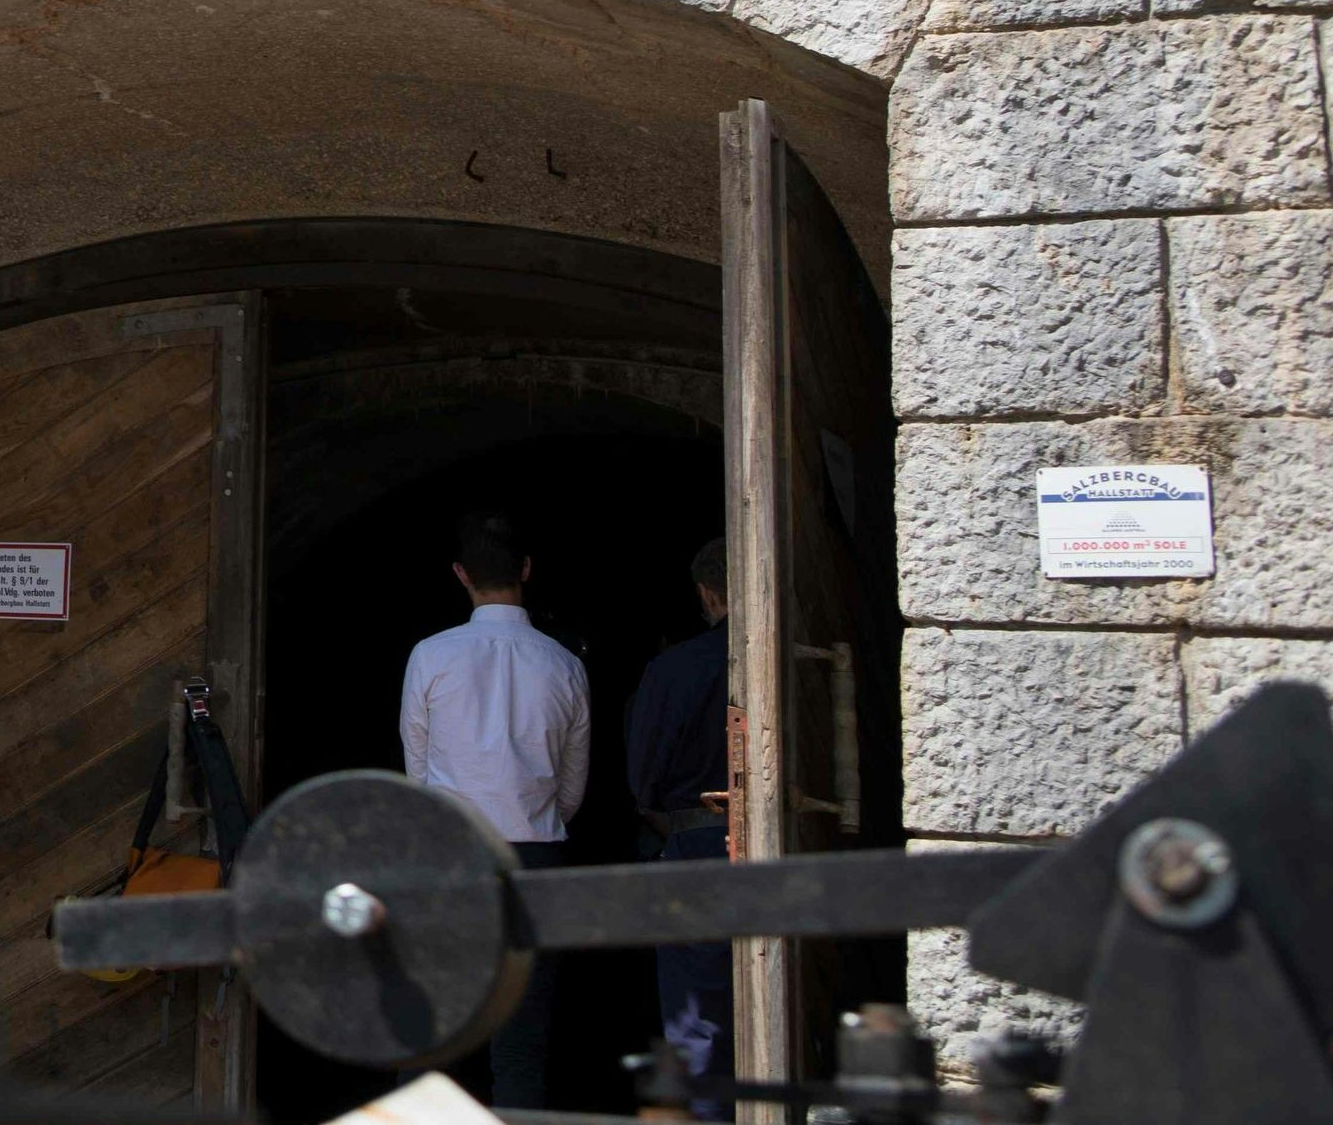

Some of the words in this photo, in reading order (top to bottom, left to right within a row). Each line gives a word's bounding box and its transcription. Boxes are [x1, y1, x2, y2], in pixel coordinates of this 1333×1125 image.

[1063, 471, 1182, 501] SALZBERGBAU
[1089, 488, 1155, 497] HALLSTATT
[1063, 541, 1129, 551] 1.000.000
[1154, 541, 1187, 550] SOLE
[18, 553, 31, 562] des
[1059, 561, 1073, 569] im
[1075, 559, 1161, 570] Wirtschaftsjahr
[1163, 560, 1194, 568] 2000
[17, 565, 26, 573] ist
[29, 565, 40, 574] für
[36, 576, 49, 585] der
[22, 588, 55, 597] verboten
